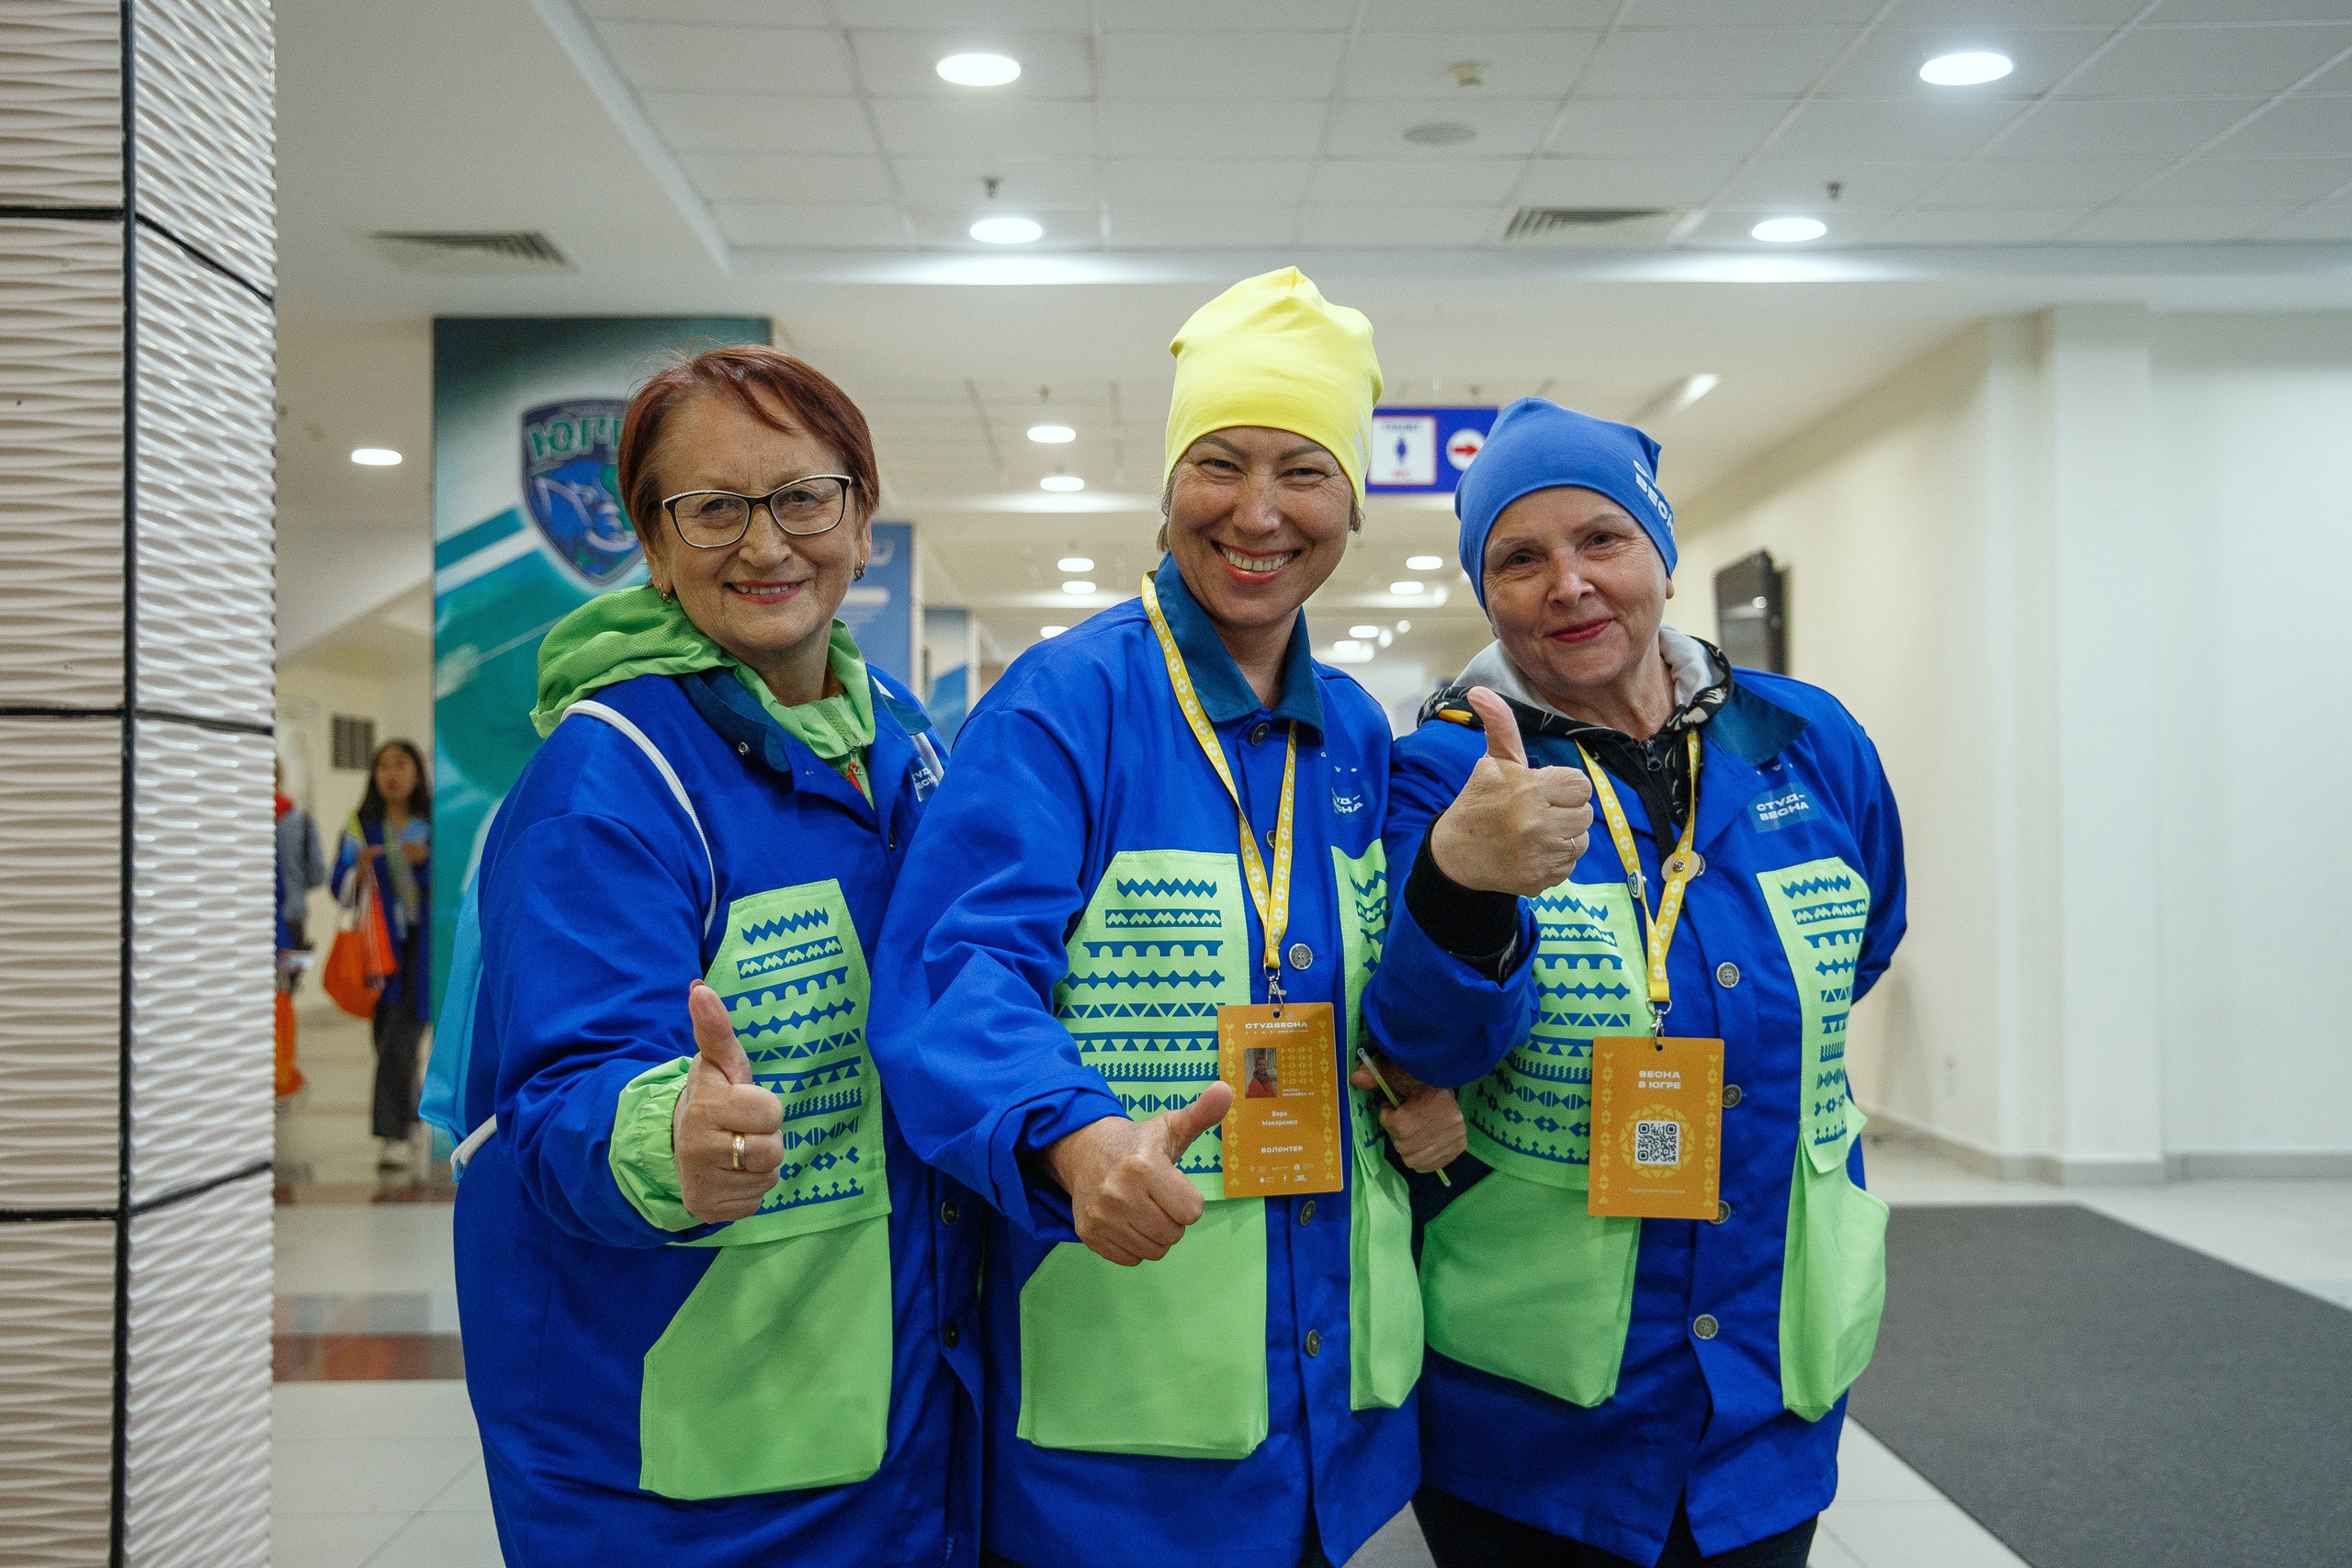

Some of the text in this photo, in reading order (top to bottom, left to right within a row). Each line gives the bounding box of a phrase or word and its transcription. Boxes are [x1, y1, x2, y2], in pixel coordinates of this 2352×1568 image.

[528, 415, 622, 459] ЮГ
[1635, 472, 1676, 540] ВЕСН
[1756, 793, 1806, 811] СТУД-
[1758, 801, 1809, 821] ВЕСНА
[1638, 1070, 1681, 1078] ВЕСНА
[1648, 1081, 1681, 1089] ЮГРЕ
[1261, 1145, 1304, 1154] ВОЛОНТЕР
